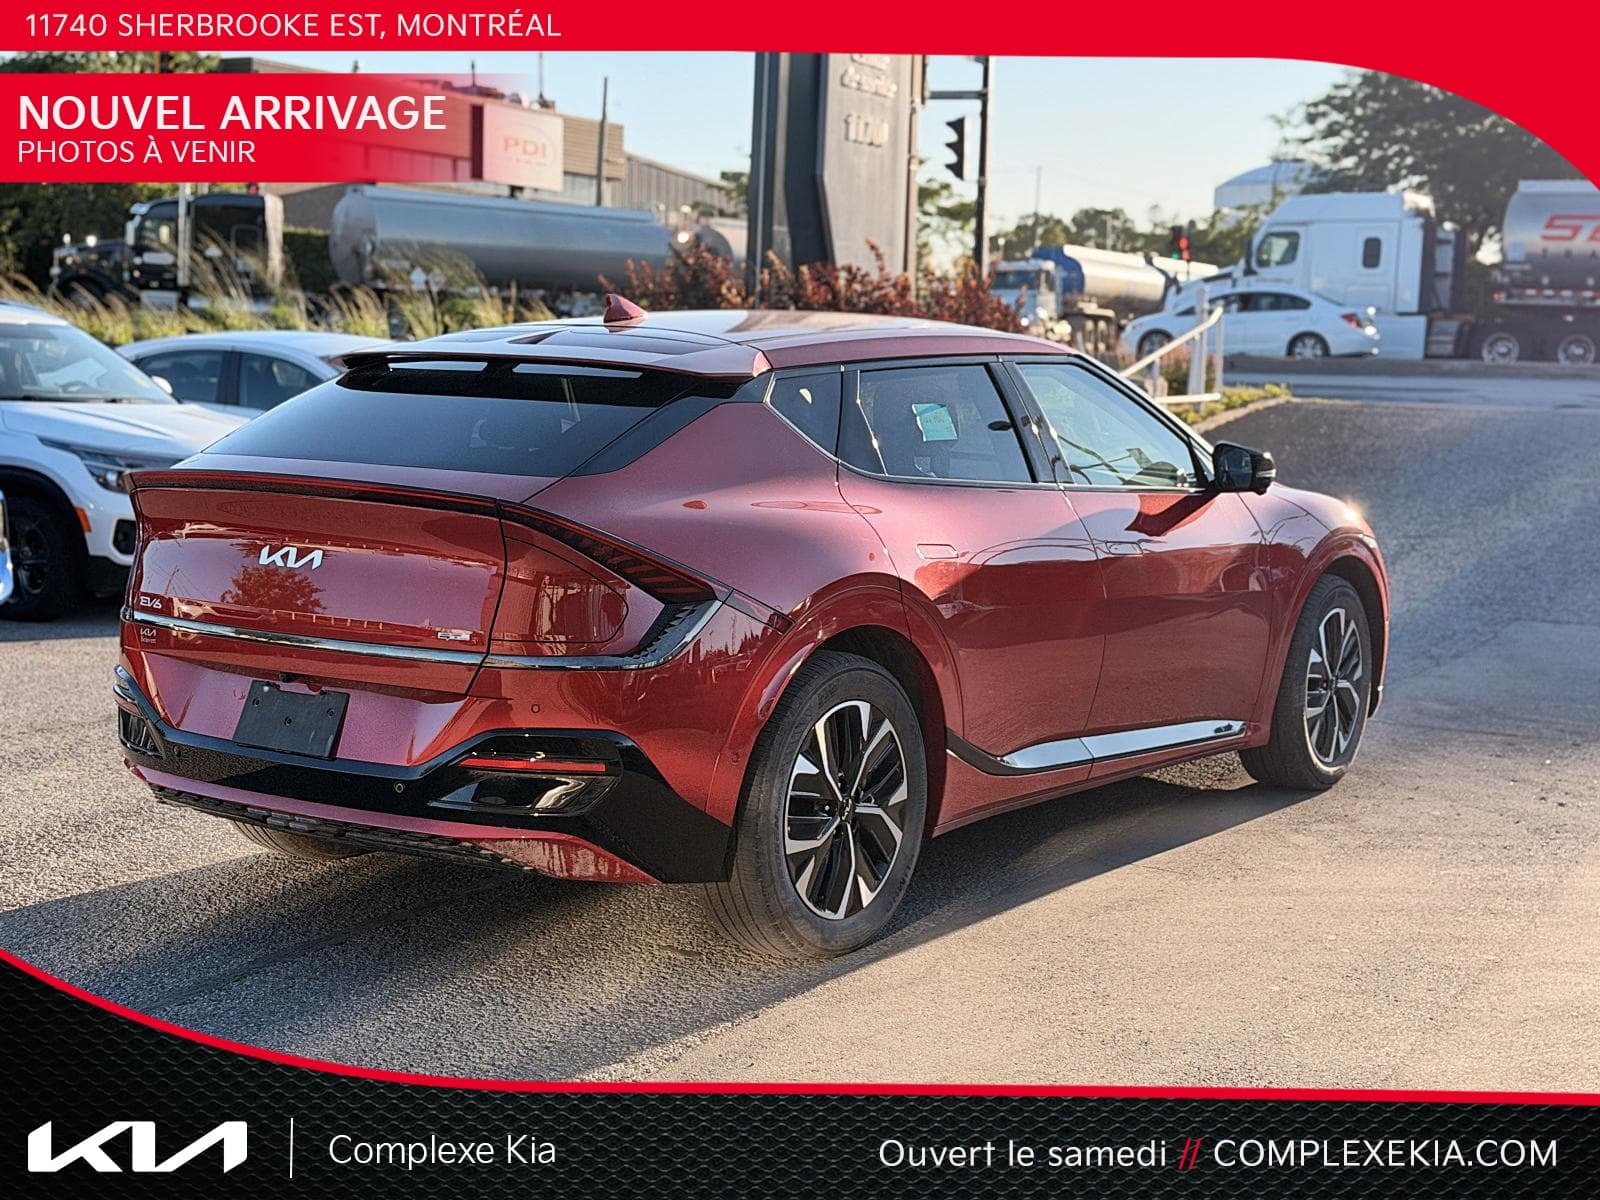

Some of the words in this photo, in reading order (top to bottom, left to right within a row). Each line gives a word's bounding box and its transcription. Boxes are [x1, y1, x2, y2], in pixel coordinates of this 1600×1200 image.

[503, 136, 547, 158] PDI
[258, 544, 324, 570] KIA
[140, 595, 162, 609] EV6
